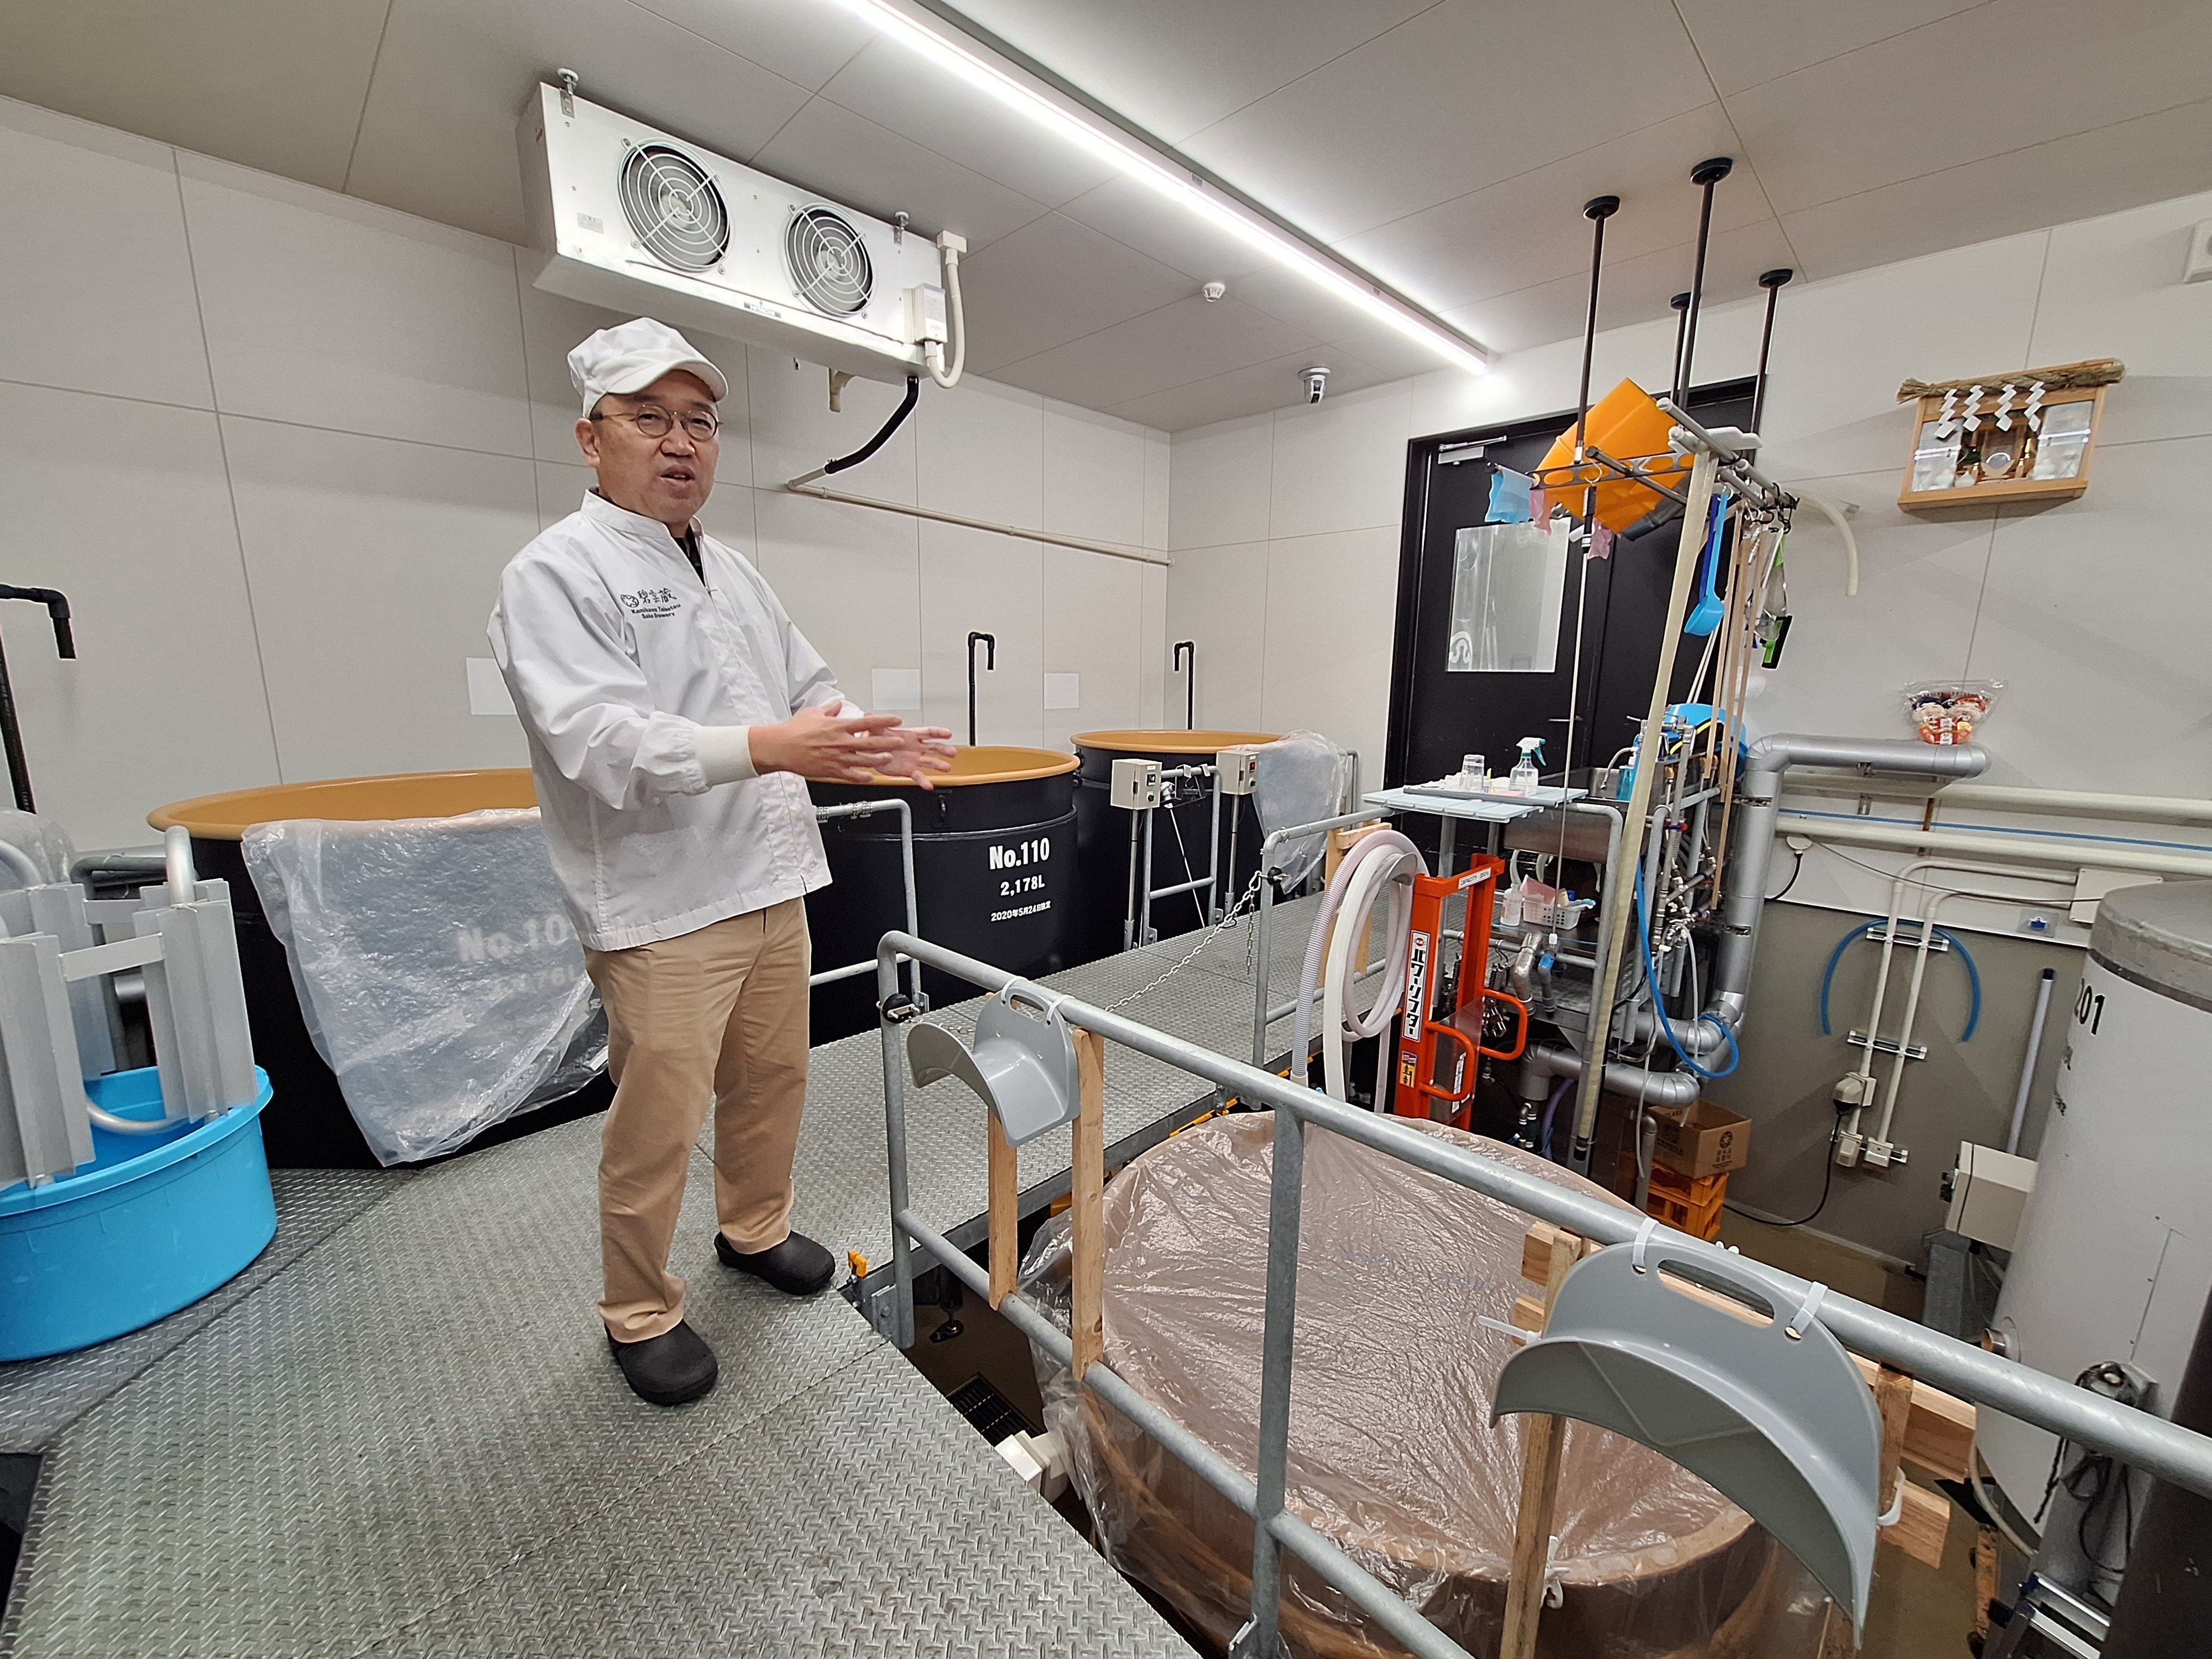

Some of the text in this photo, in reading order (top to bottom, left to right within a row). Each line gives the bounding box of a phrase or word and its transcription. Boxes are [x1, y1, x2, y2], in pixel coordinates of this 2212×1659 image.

[750, 304, 775, 316] HITACHI
[989, 837, 1050, 870] No.110
[1000, 874, 1045, 896] 2,178L
[1406, 948, 1426, 1035] パワーリフター
